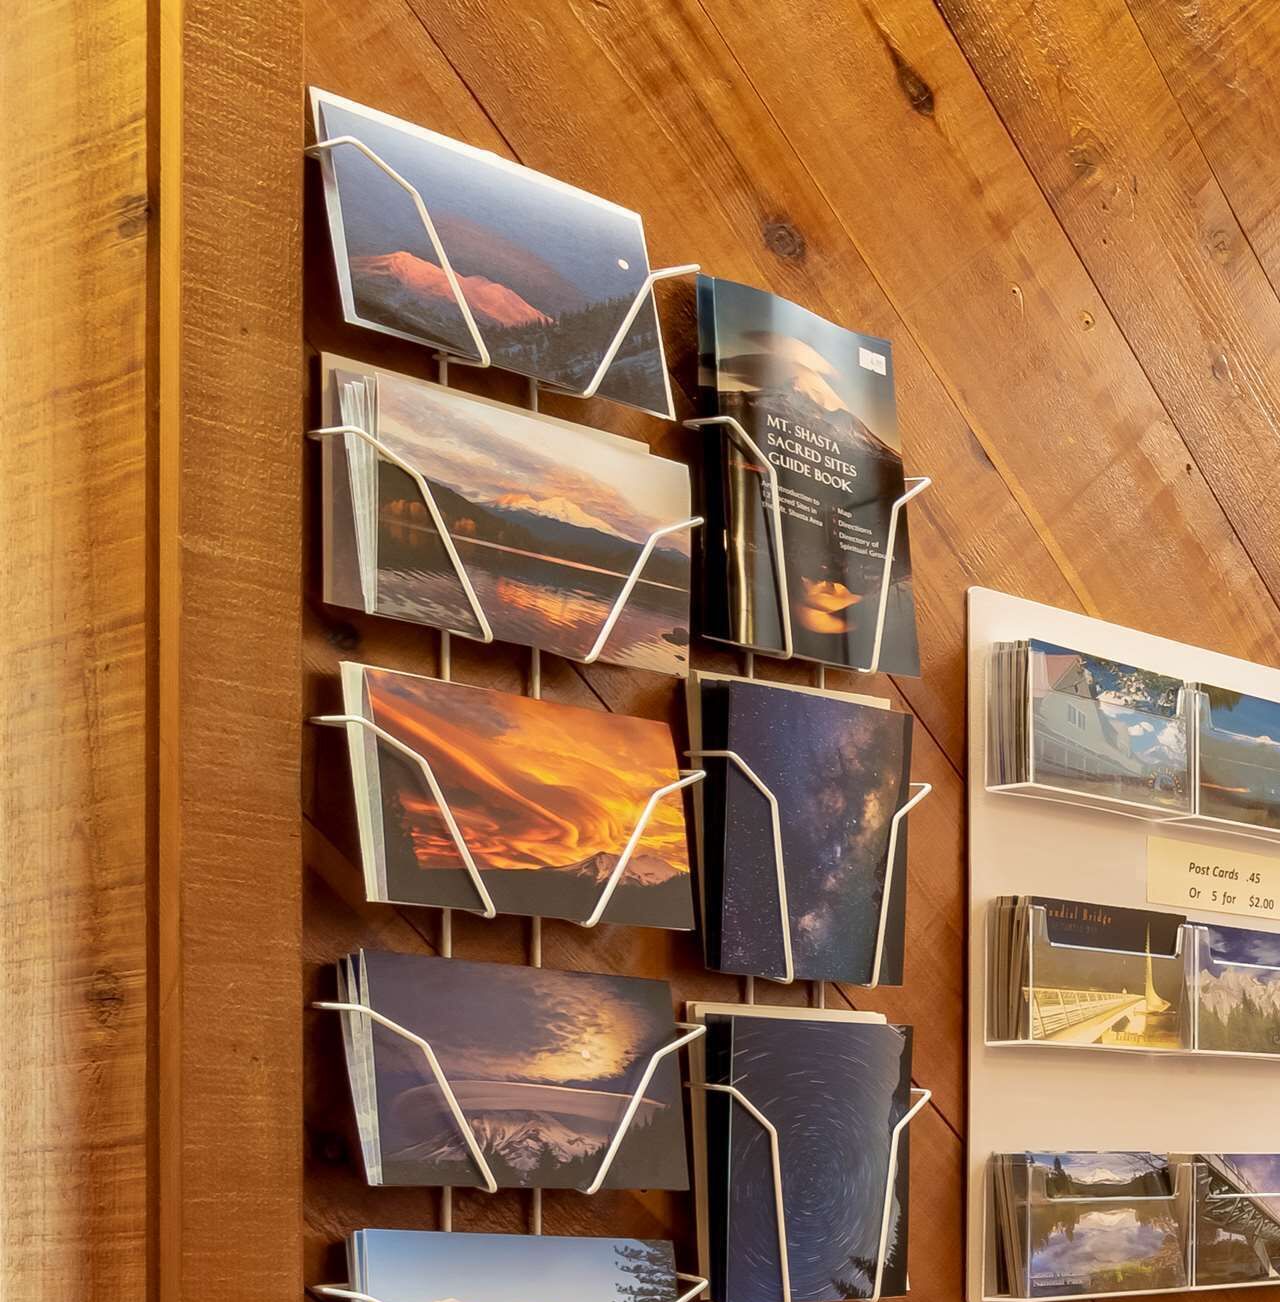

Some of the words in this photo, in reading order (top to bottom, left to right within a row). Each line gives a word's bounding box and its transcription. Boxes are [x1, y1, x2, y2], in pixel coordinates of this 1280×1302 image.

[767, 414, 792, 434] MT.
[795, 425, 840, 455] SHASTA
[767, 433, 821, 463] SACRED
[824, 455, 857, 477] SITES
[768, 451, 812, 478] GUIDE
[814, 468, 854, 493] BOOK
[777, 484, 815, 504] ntroduction
[838, 519, 873, 535] Directions
[838, 531, 870, 547] Directory
[871, 541, 880, 549] of
[1188, 862, 1210, 876] Post
[1212, 866, 1239, 880] Cards
[1245, 872, 1262, 884] .45
[1188, 887, 1202, 899] Or
[1211, 890, 1218, 902] 5
[1221, 891, 1237, 906] for
[1248, 895, 1275, 910] $2.00
[1048, 903, 1079, 920] undial
